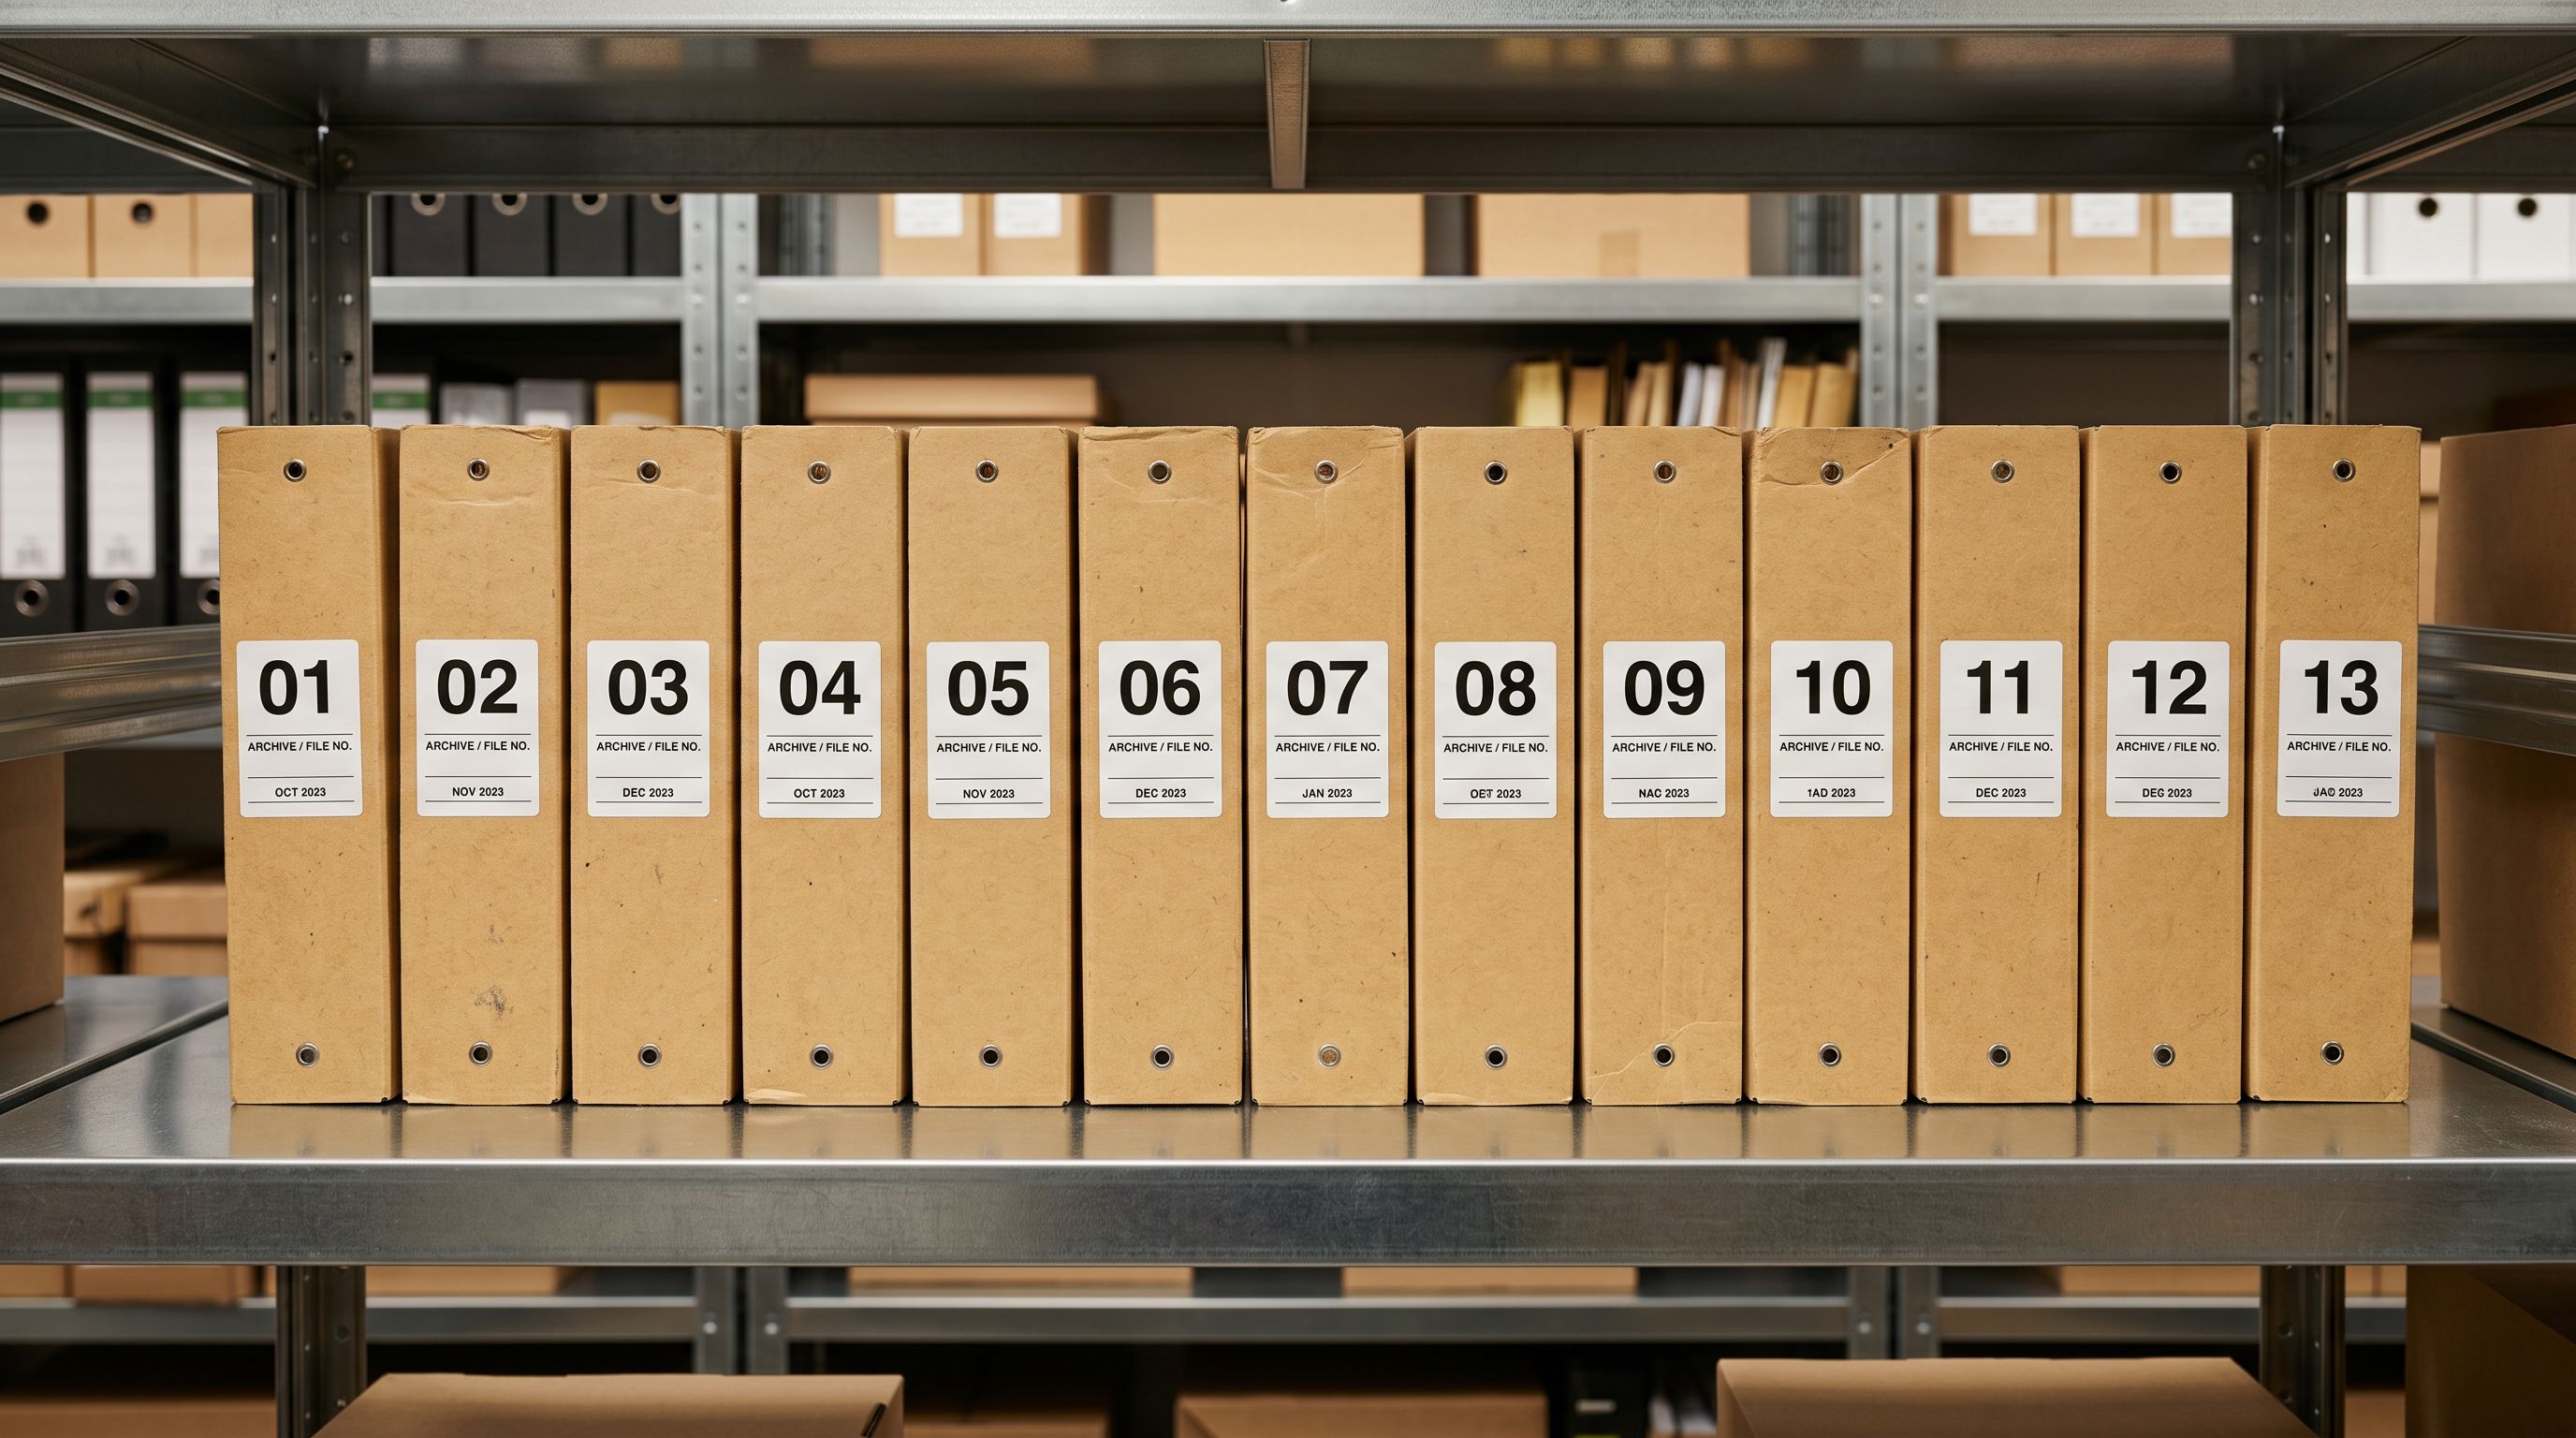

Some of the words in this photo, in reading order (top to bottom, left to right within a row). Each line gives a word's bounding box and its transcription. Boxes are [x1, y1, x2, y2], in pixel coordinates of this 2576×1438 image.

[259, 659, 329, 716] 01
[437, 658, 518, 715] 02
[607, 659, 689, 716] 03
[779, 659, 861, 716] 04
[947, 660, 1030, 716] 05
[1120, 659, 1201, 716] 06
[1287, 660, 1368, 716] 07
[1456, 660, 1536, 717] 08
[1624, 659, 1705, 716] 09
[1795, 659, 1871, 716] 10
[1967, 660, 2029, 714] 11
[2131, 660, 2207, 715] 12
[2304, 659, 2378, 716] 13
[247, 741, 299, 752] ARCHIVE
[298, 741, 304, 752] /
[305, 741, 330, 752] FILE
[331, 741, 353, 752] NO.
[425, 741, 476, 751] ARCHIVE
[476, 741, 482, 751] /
[483, 741, 508, 751] FILE
[509, 741, 531, 751] NO.
[596, 741, 648, 752] ARCHIVE
[647, 741, 653, 752] /
[655, 741, 680, 752] FILE
[681, 741, 702, 752] NO.
[767, 741, 818, 753] ARCHIVE
[817, 741, 824, 753] /
[826, 741, 850, 753] FILE
[852, 741, 872, 753] NO.
[936, 742, 988, 753] ARCHIVE
[987, 742, 993, 753] /
[994, 742, 1019, 753] FILE
[1020, 742, 1042, 753] NO.
[1108, 741, 1160, 753] ARCHIVE
[1159, 741, 1165, 753] /
[1166, 741, 1192, 753] FILE
[1193, 741, 1214, 753] NO.
[1275, 741, 1326, 753] ARCHIVE
[1325, 741, 1332, 753] /
[1333, 741, 1358, 753] FILE
[1359, 741, 1381, 753] NO.
[1443, 742, 1495, 753] ARCHIVE
[1494, 742, 1500, 753] /
[1501, 742, 1527, 753] FILE
[1528, 742, 1549, 753] NO.
[1612, 741, 1663, 753] ARCHIVE
[1662, 741, 1669, 753] /
[1670, 741, 1695, 753] FILE
[1696, 741, 1718, 753] NO.
[1779, 741, 1831, 752] ARCHIVE
[1830, 741, 1837, 752] /
[1838, 741, 1863, 752] FILE
[1865, 741, 1885, 752] NO.
[1949, 741, 2000, 752] ARCHIVE
[1999, 741, 2006, 752] /
[2007, 741, 2032, 752] FILE
[2033, 741, 2055, 752] NO.
[2115, 741, 2167, 753] ARCHIVE
[2166, 741, 2173, 753] /
[2174, 741, 2199, 753] FILE
[2200, 741, 2221, 753] NO.
[2287, 741, 2338, 752] ARCHIVE
[2337, 741, 2344, 752] /
[2346, 741, 2370, 752] FILE
[2372, 741, 2393, 752] NO.
[274, 787, 299, 798] OCT
[300, 786, 327, 798] 2023
[452, 786, 476, 797] NOV
[478, 786, 505, 797] 2023
[622, 787, 646, 798] DEC
[649, 787, 674, 798] 2023
[793, 788, 818, 799] OCT
[820, 788, 845, 799] 2023
[962, 788, 988, 799] NOV
[989, 788, 1016, 799] 2023
[1135, 787, 1159, 799] DEC
[1161, 787, 1187, 799] 2023
[1302, 788, 1325, 799] JAN
[1327, 788, 1353, 799] 2023
[1496, 788, 1522, 799] 2023
[1638, 787, 1662, 799] NAC
[1664, 788, 1690, 799] 2023
[1831, 787, 1856, 798] 2023
[1976, 787, 1999, 798] DEC
[2001, 787, 2027, 798] 2023
[2167, 787, 2193, 799] 2023
[2338, 787, 2364, 798] 2023
